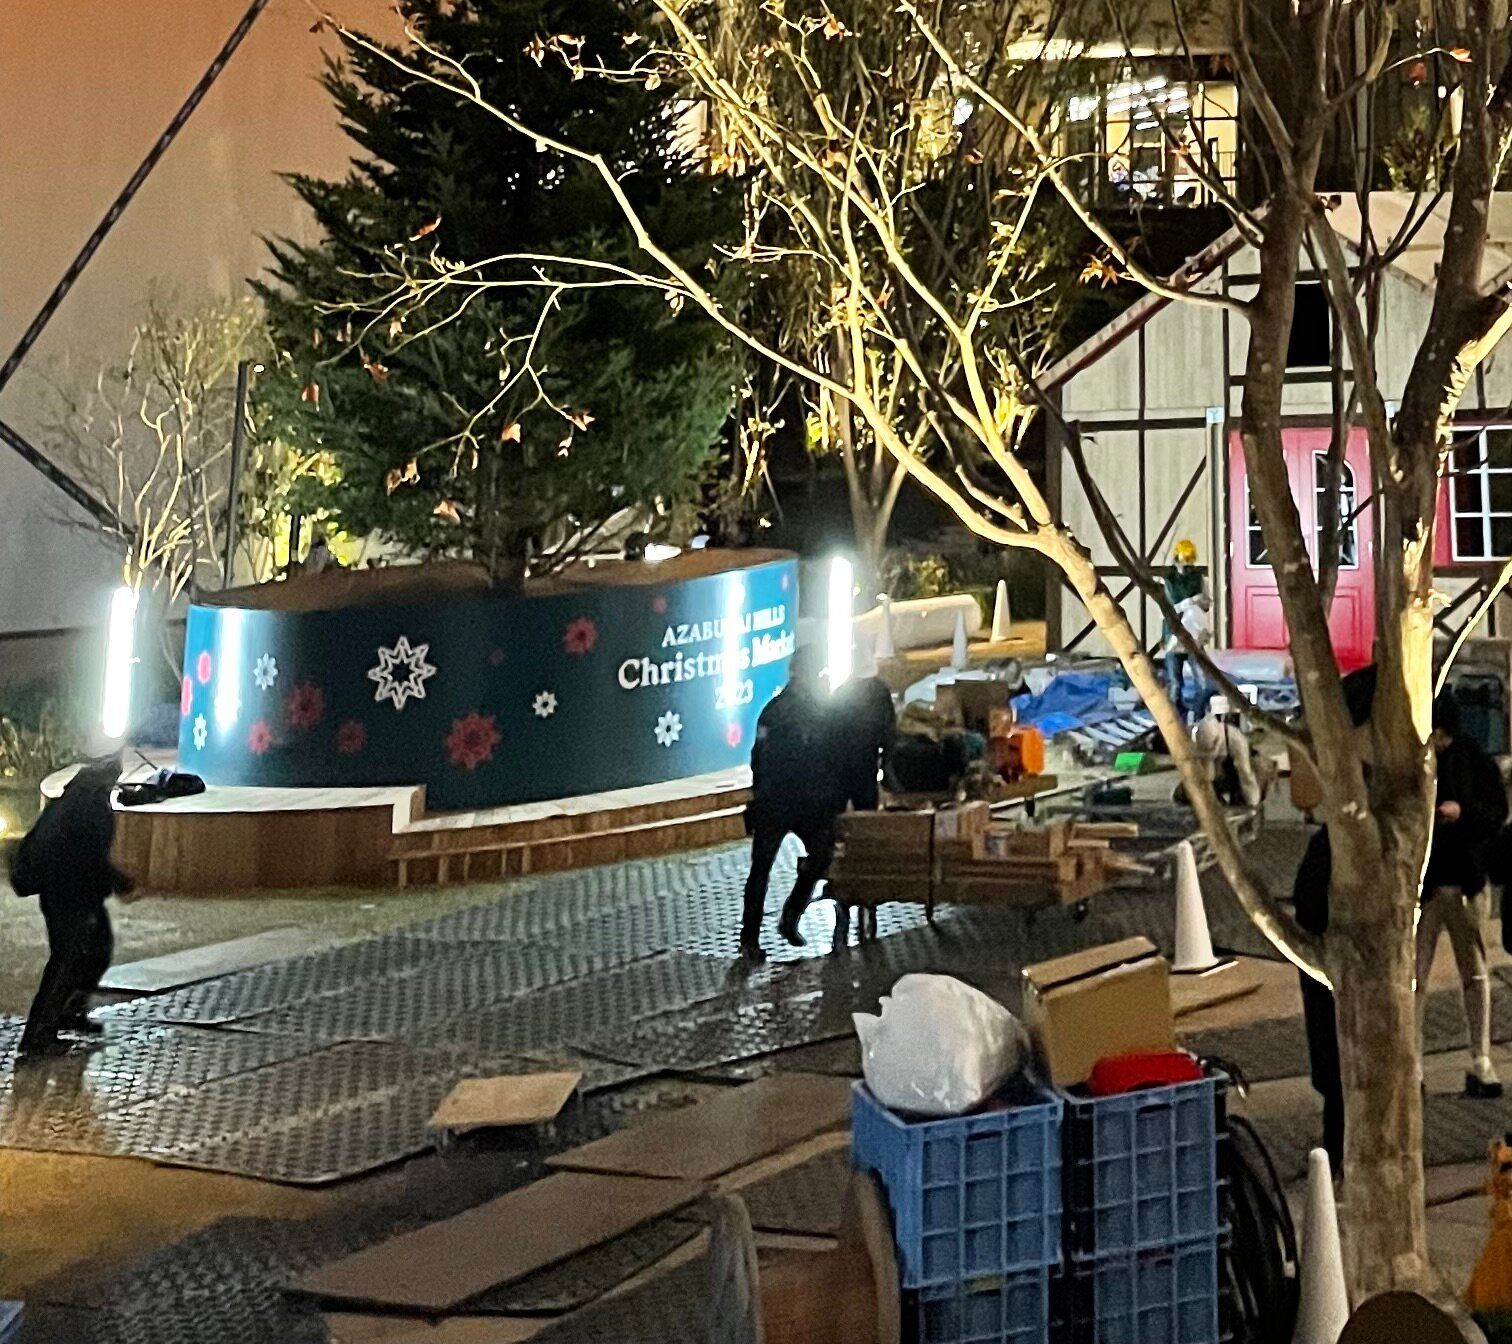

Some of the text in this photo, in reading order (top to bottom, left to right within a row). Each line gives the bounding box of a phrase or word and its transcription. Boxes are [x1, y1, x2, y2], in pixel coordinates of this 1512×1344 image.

[661, 613, 751, 647] AZABUAI
[618, 646, 751, 690] Christms
[714, 679, 754, 710] 223
